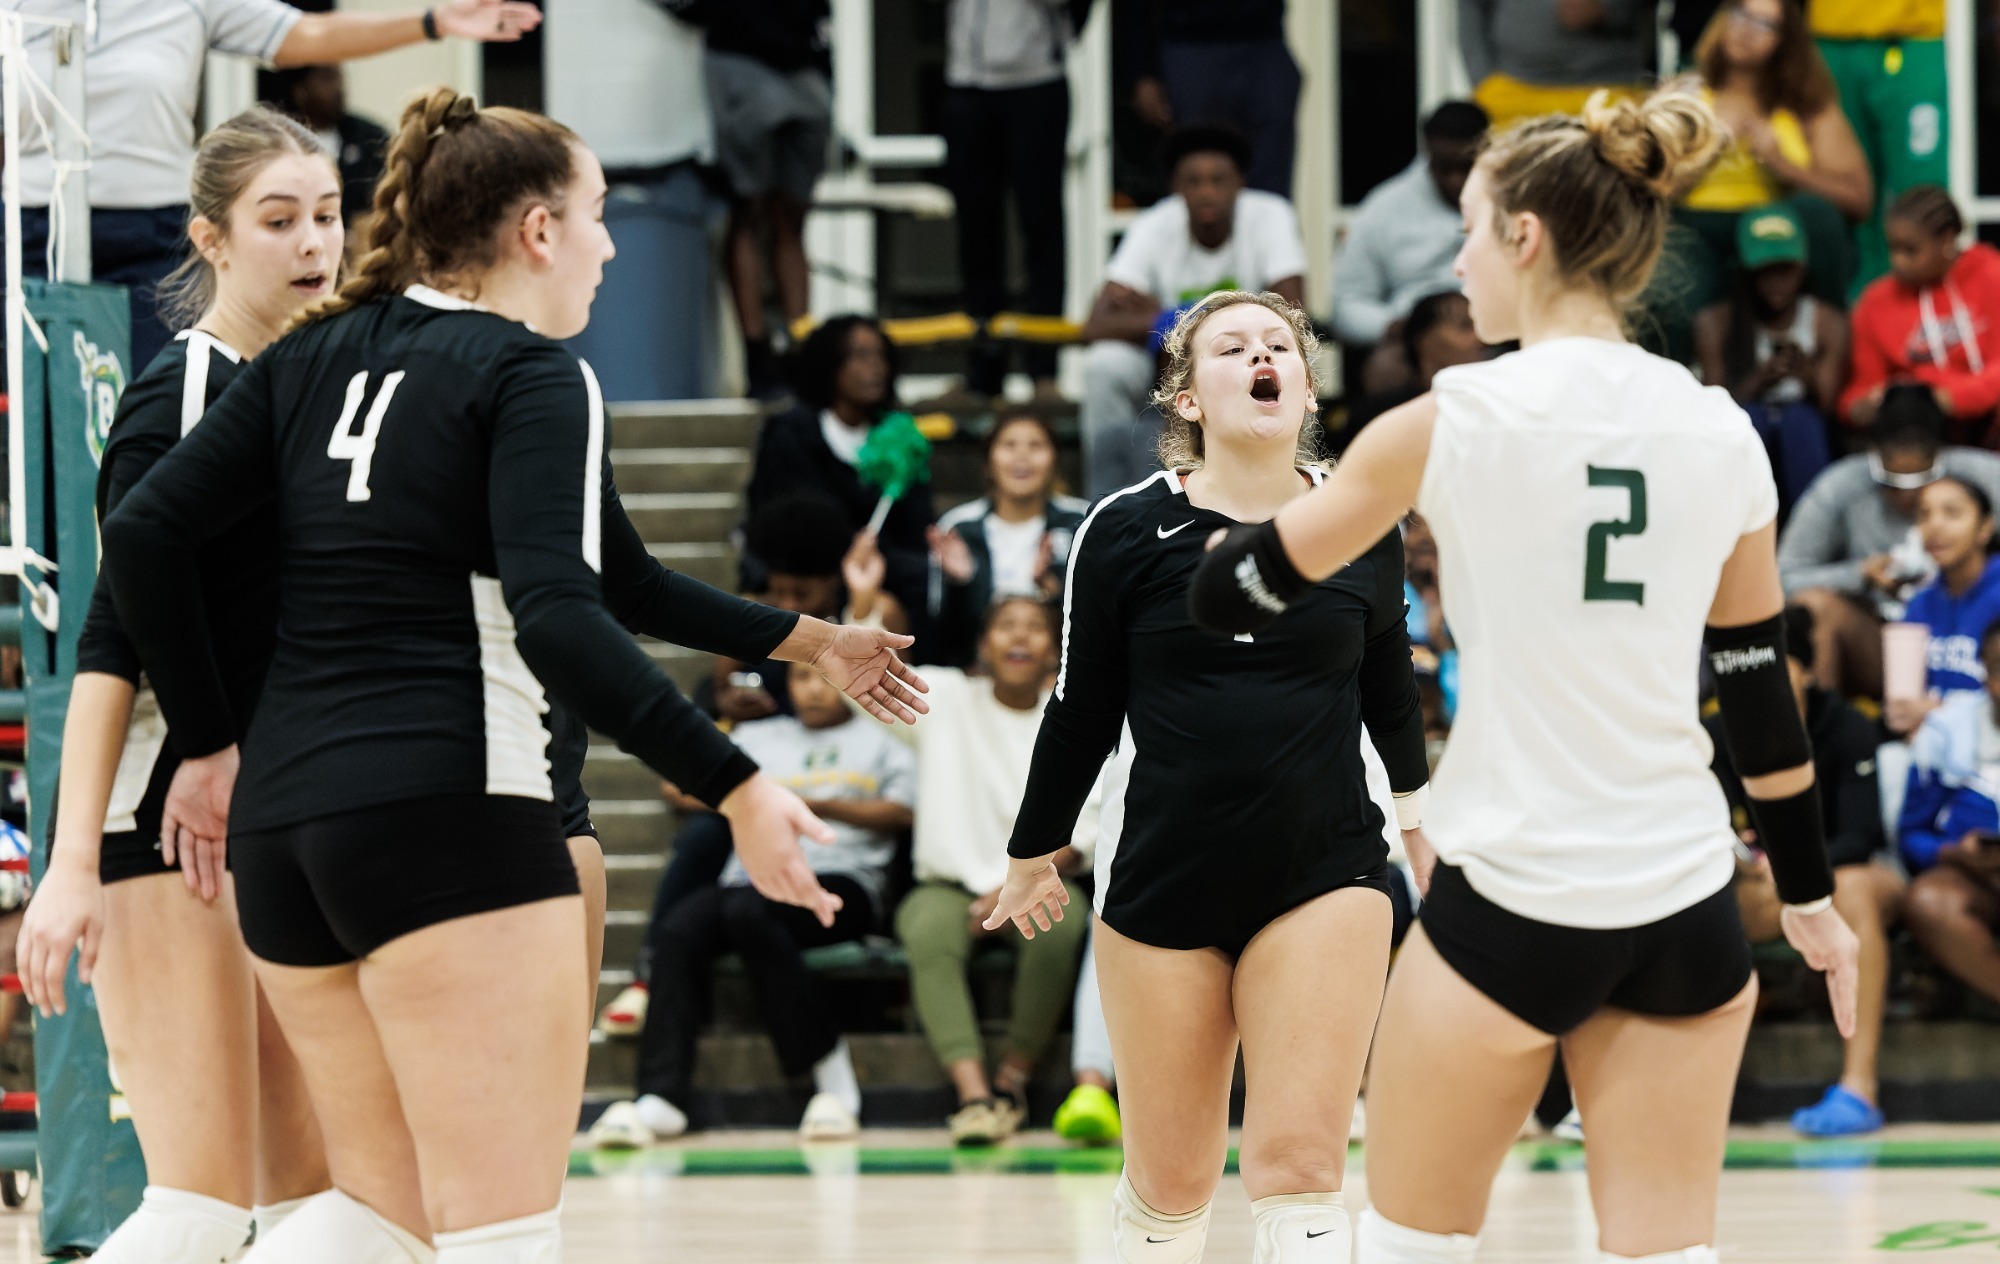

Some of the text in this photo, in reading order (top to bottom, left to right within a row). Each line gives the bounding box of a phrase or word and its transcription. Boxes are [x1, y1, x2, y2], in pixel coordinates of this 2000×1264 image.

[97, 380, 116, 439] B
[327, 369, 406, 502] 4
[1584, 463, 1646, 606] 2
